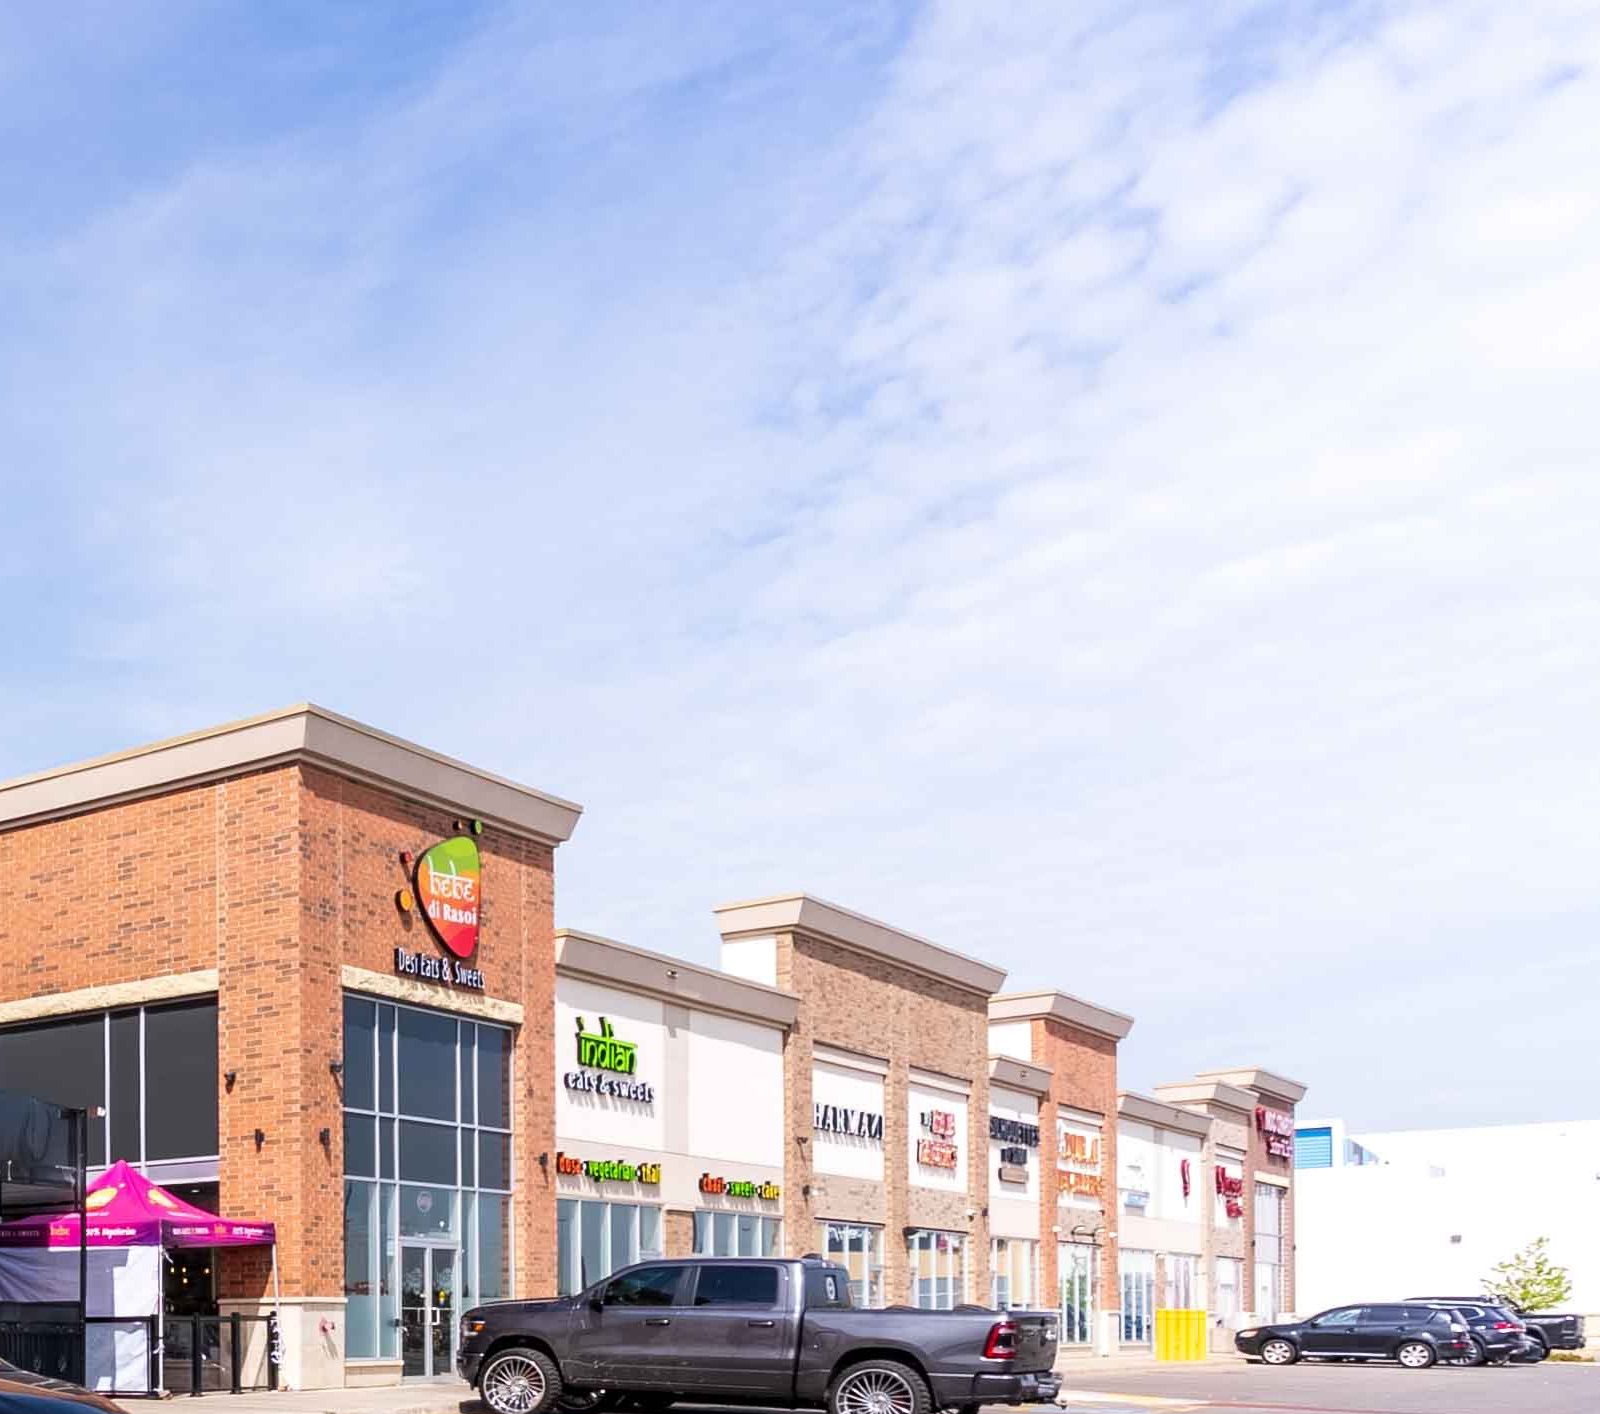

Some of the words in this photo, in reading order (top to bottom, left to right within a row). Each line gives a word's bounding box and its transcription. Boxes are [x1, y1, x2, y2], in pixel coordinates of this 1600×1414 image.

[428, 900, 440, 919] di
[443, 903, 477, 926] Rasoi
[398, 947, 418, 973] Desi
[421, 953, 440, 979] Eats
[455, 960, 486, 989] Sweets
[566, 1070, 597, 1092] eats
[613, 1080, 655, 1103] sweets
